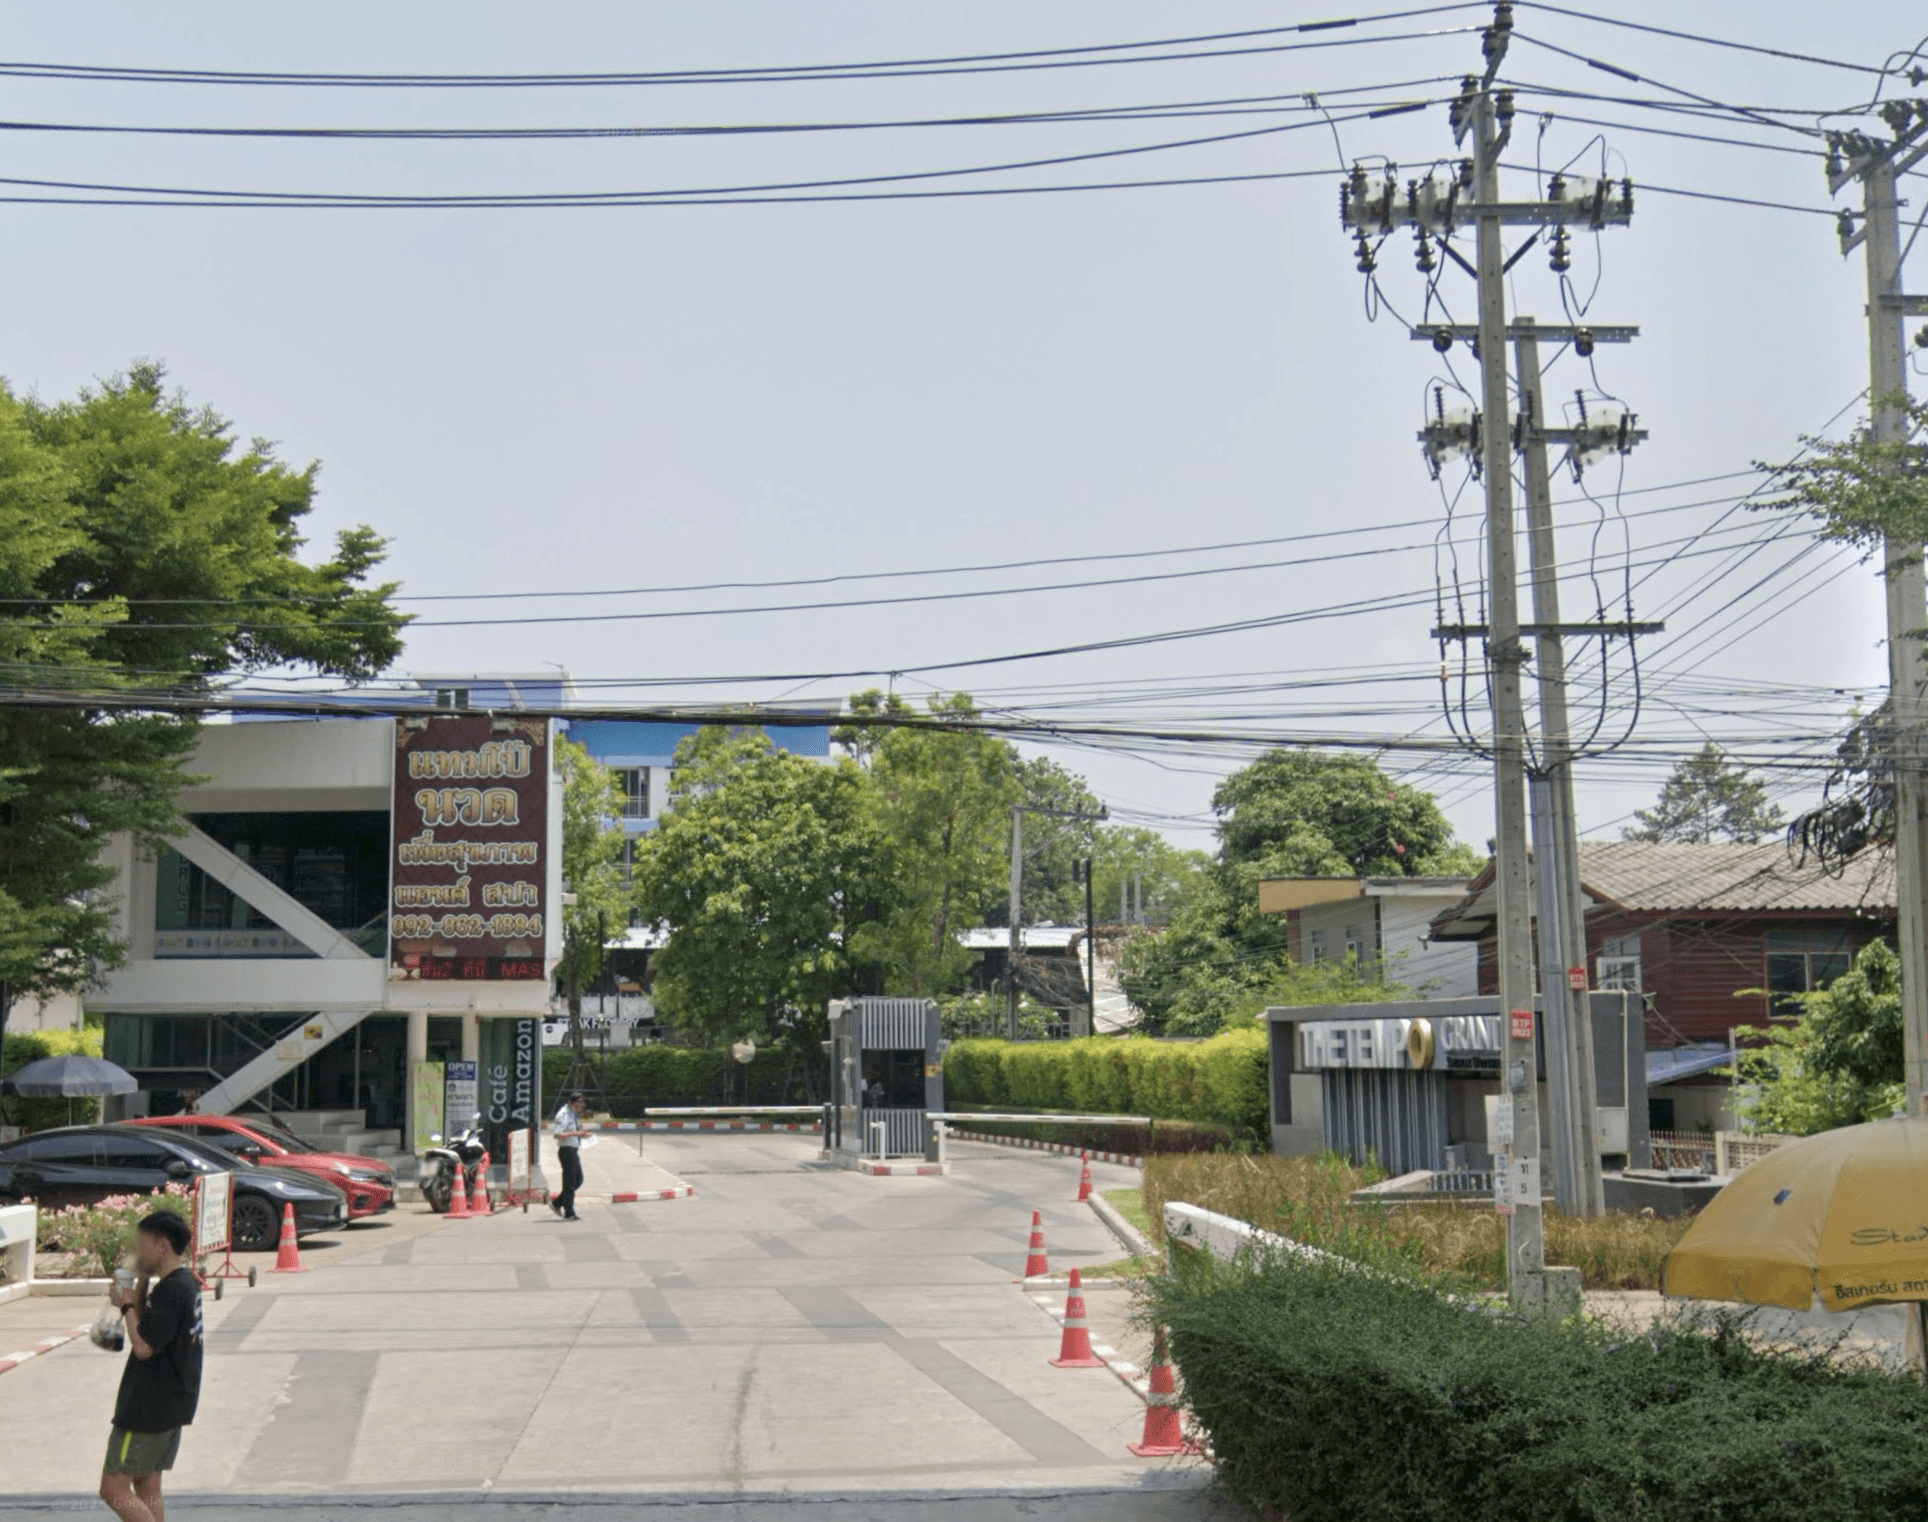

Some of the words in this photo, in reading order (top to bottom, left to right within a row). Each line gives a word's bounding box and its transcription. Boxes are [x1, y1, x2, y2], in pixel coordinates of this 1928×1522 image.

[415, 787, 519, 826] นวด
[398, 829, 538, 873] เพื่อสุขภาพ
[394, 875, 471, 907] แอนด์
[483, 881, 538, 907] สปา
[391, 913, 543, 937] 092-862-1884
[447, 1062, 474, 1072] OPEN
[512, 1019, 533, 1123] Amazon
[488, 1065, 508, 1124] Café
